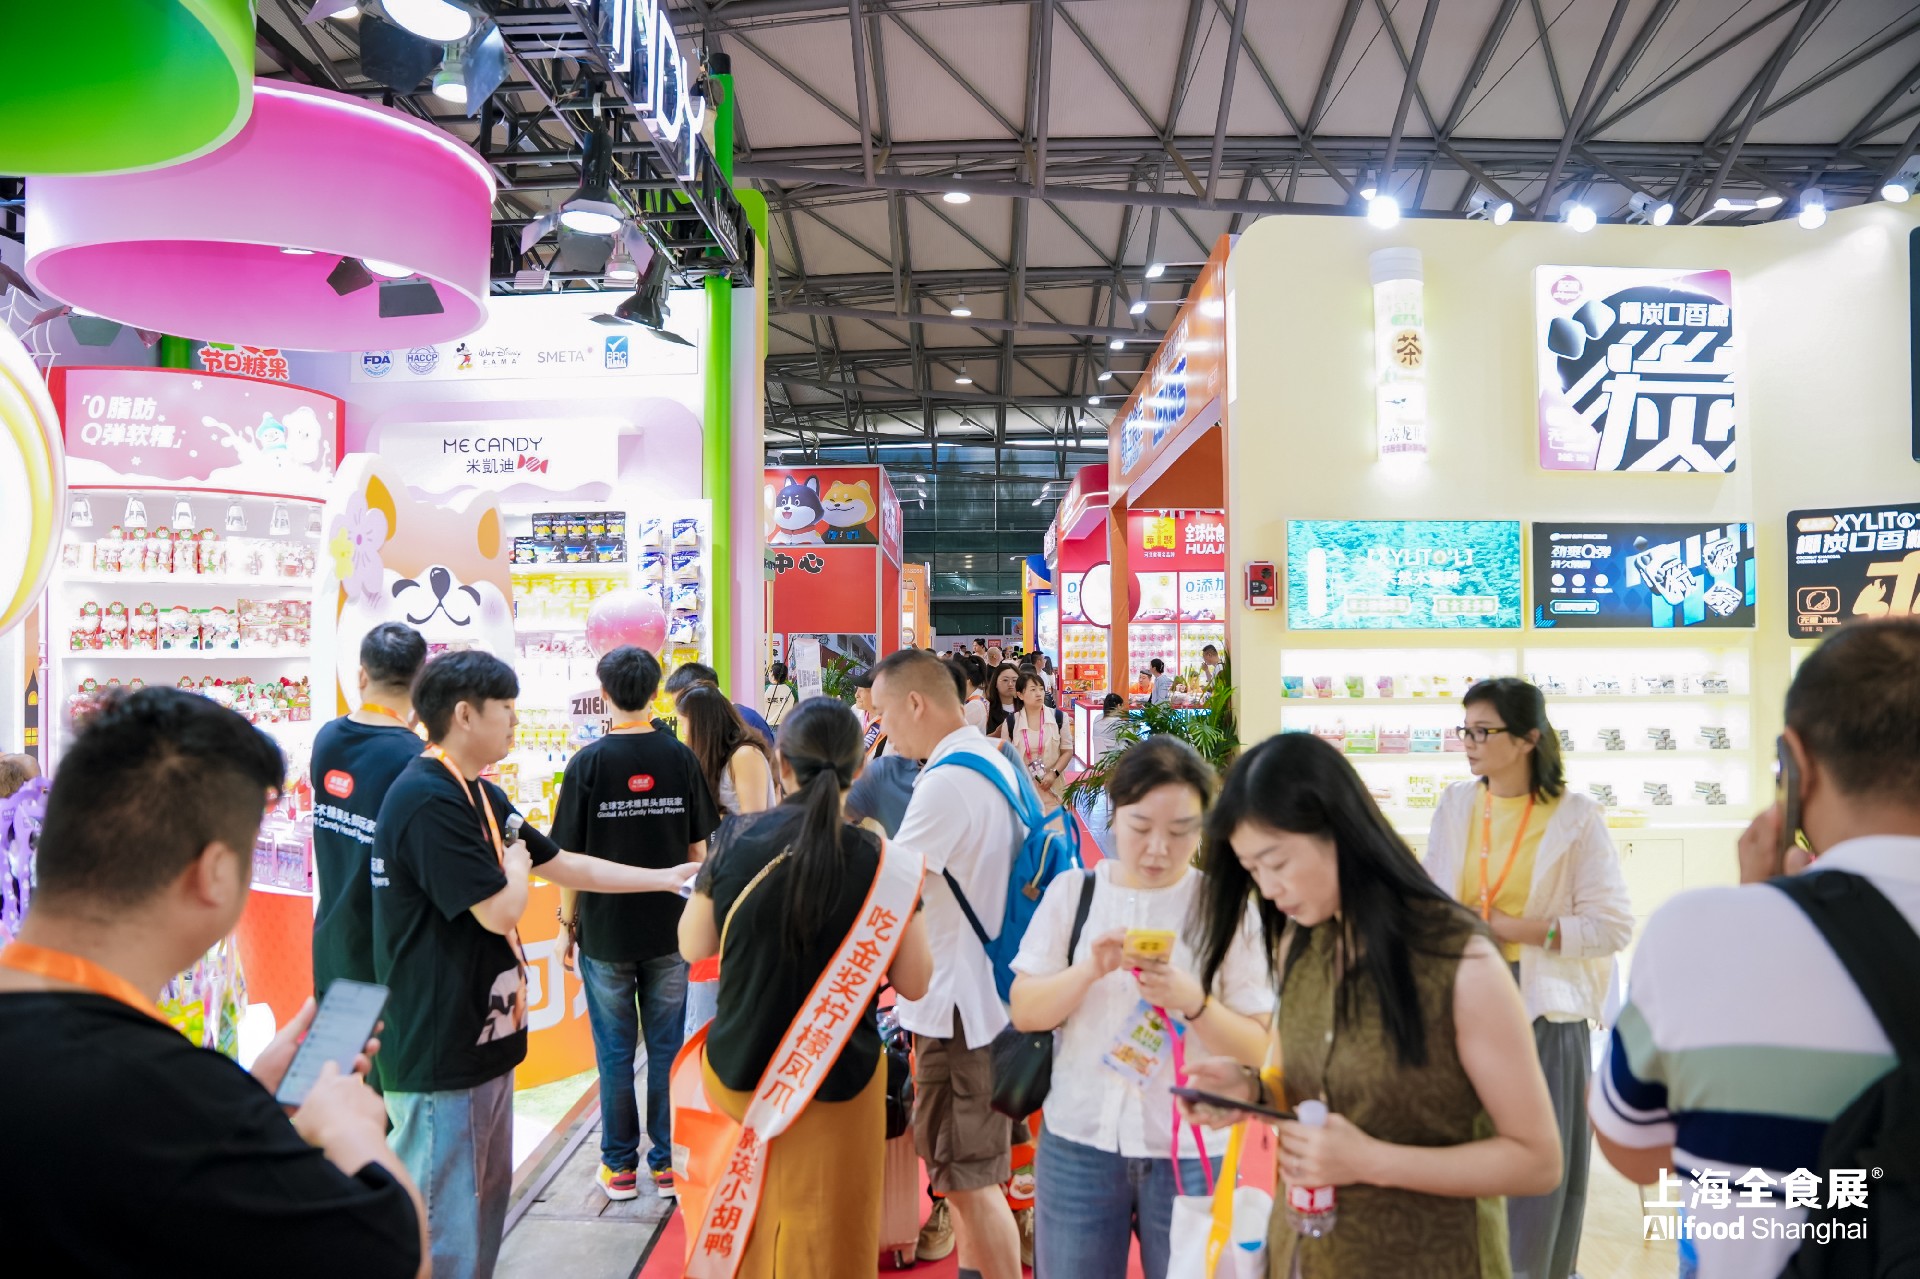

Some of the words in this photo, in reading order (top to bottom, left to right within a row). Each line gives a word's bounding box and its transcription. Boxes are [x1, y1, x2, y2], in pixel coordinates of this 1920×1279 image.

[407, 353, 438, 362] HACCP
[537, 350, 584, 364] SMETA
[1396, 334, 1422, 366] 茶
[200, 349, 289, 380] 节日糖果
[363, 355, 391, 365] FDA
[443, 438, 470, 454] ME
[474, 437, 543, 453] CANDY
[466, 458, 515, 474] 米凱迪
[775, 552, 824, 574] 中心
[599, 796, 683, 811] 全球艺术糖果头部玩家
[617, 810, 628, 818] Art
[629, 808, 647, 817] Candy
[647, 807, 664, 815] Head
[664, 806, 685, 814] Players
[762, 905, 899, 1115] 吃金奖柠檬凤爪
